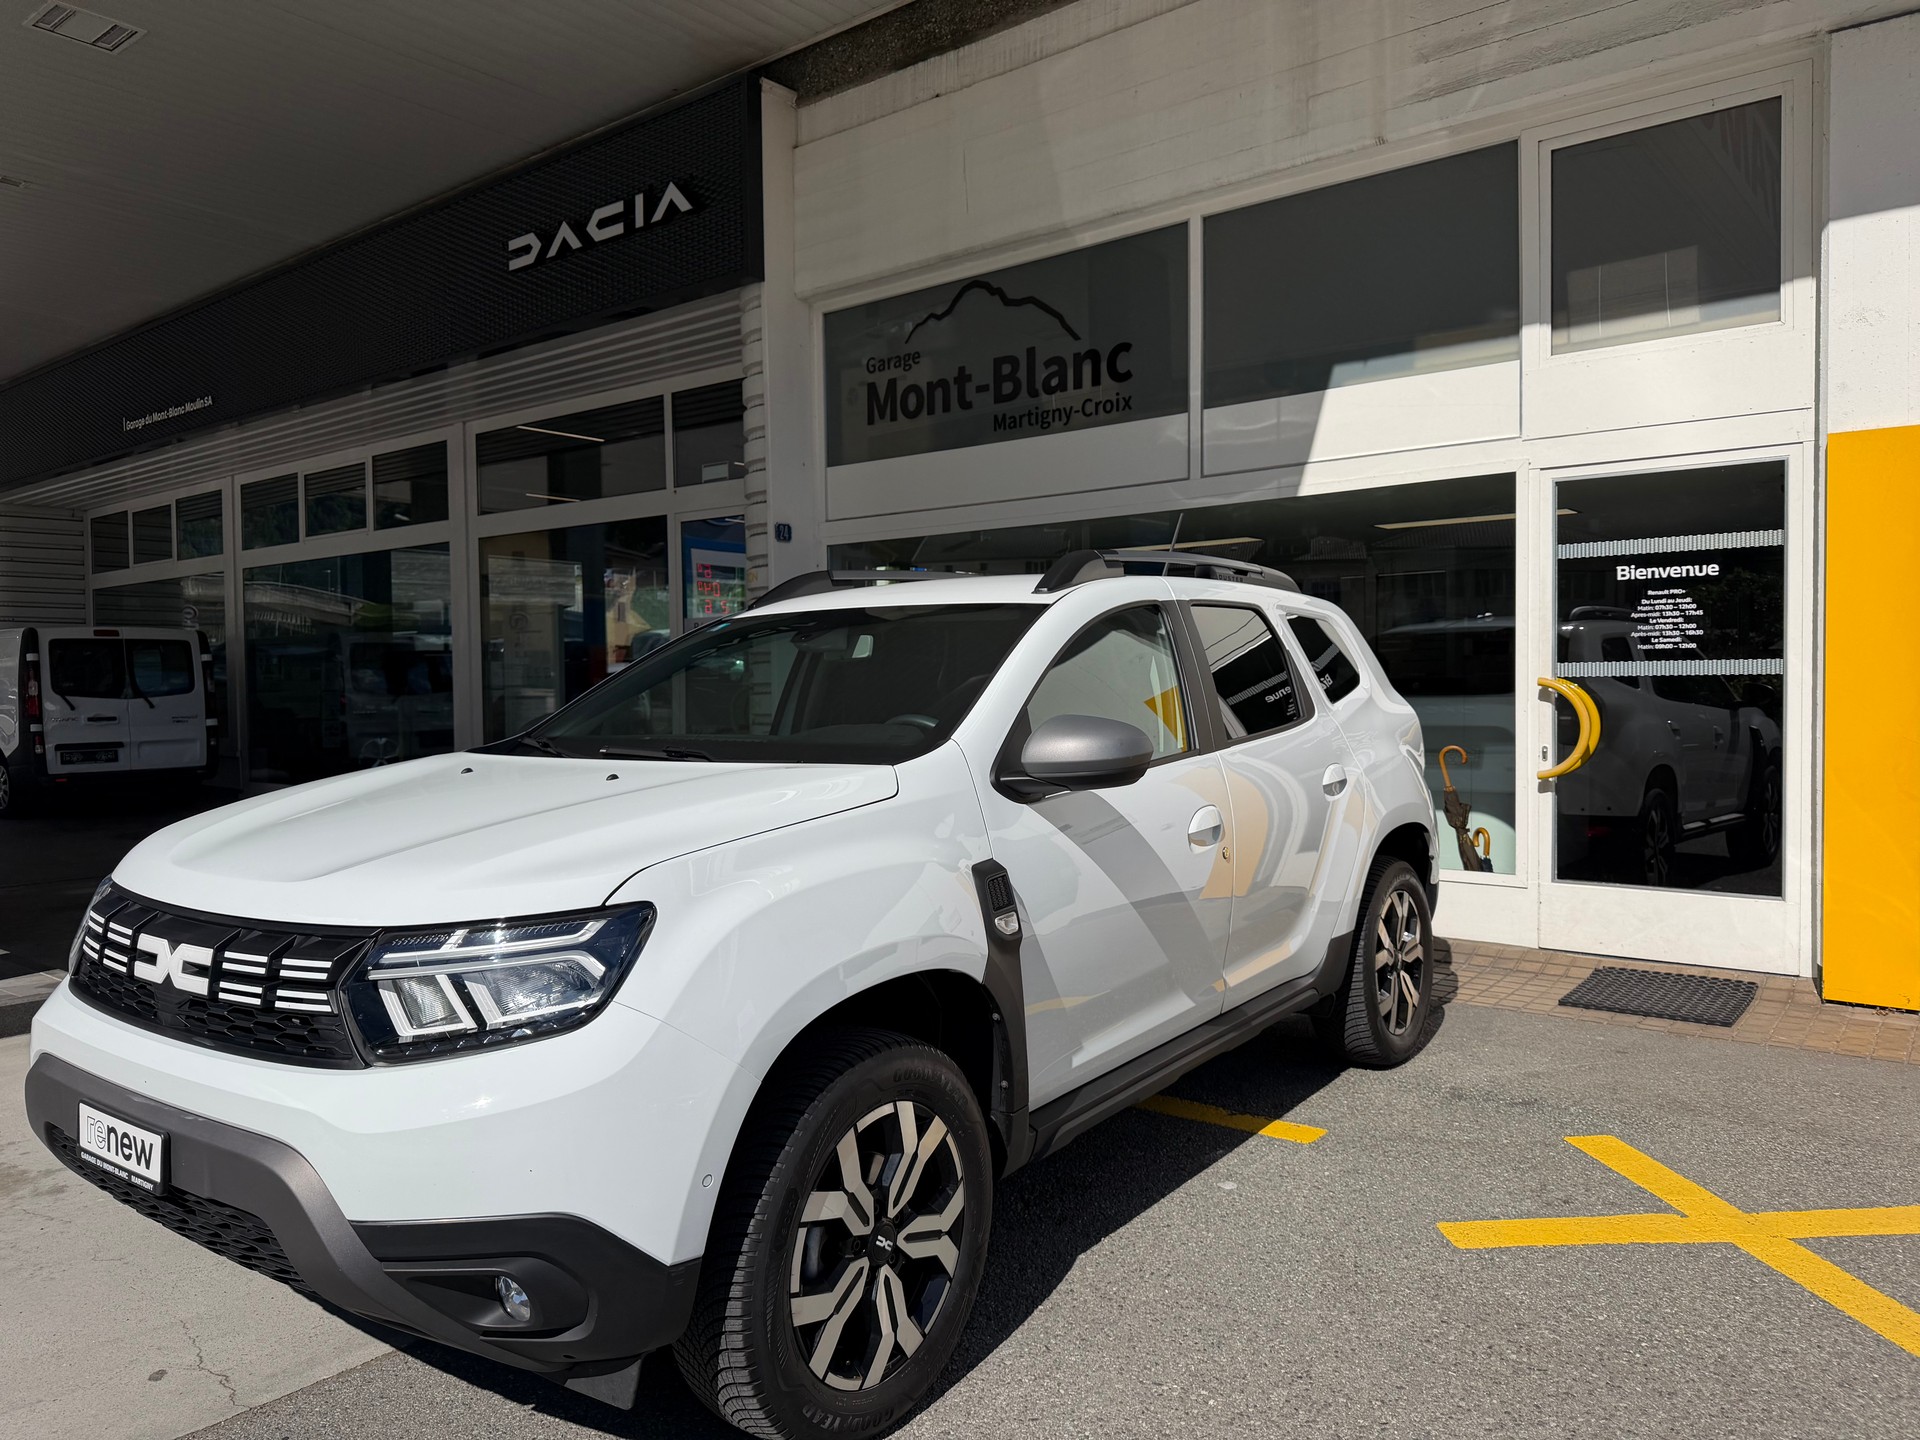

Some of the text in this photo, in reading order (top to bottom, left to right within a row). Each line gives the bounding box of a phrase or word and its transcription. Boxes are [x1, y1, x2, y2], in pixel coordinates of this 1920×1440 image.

[508, 181, 693, 271] DACIA
[866, 351, 921, 374] Garage
[866, 342, 1133, 426] Mont-Blanc
[126, 417, 145, 429] Garage
[145, 414, 152, 424] du
[152, 406, 185, 422] Mont-Blanc
[204, 395, 213, 407] SA
[993, 392, 1132, 432] Martigny-Croix
[1616, 563, 1719, 580] Bienvenue
[87, 1115, 154, 1170] renew
[96, 1159, 103, 1167] DU
